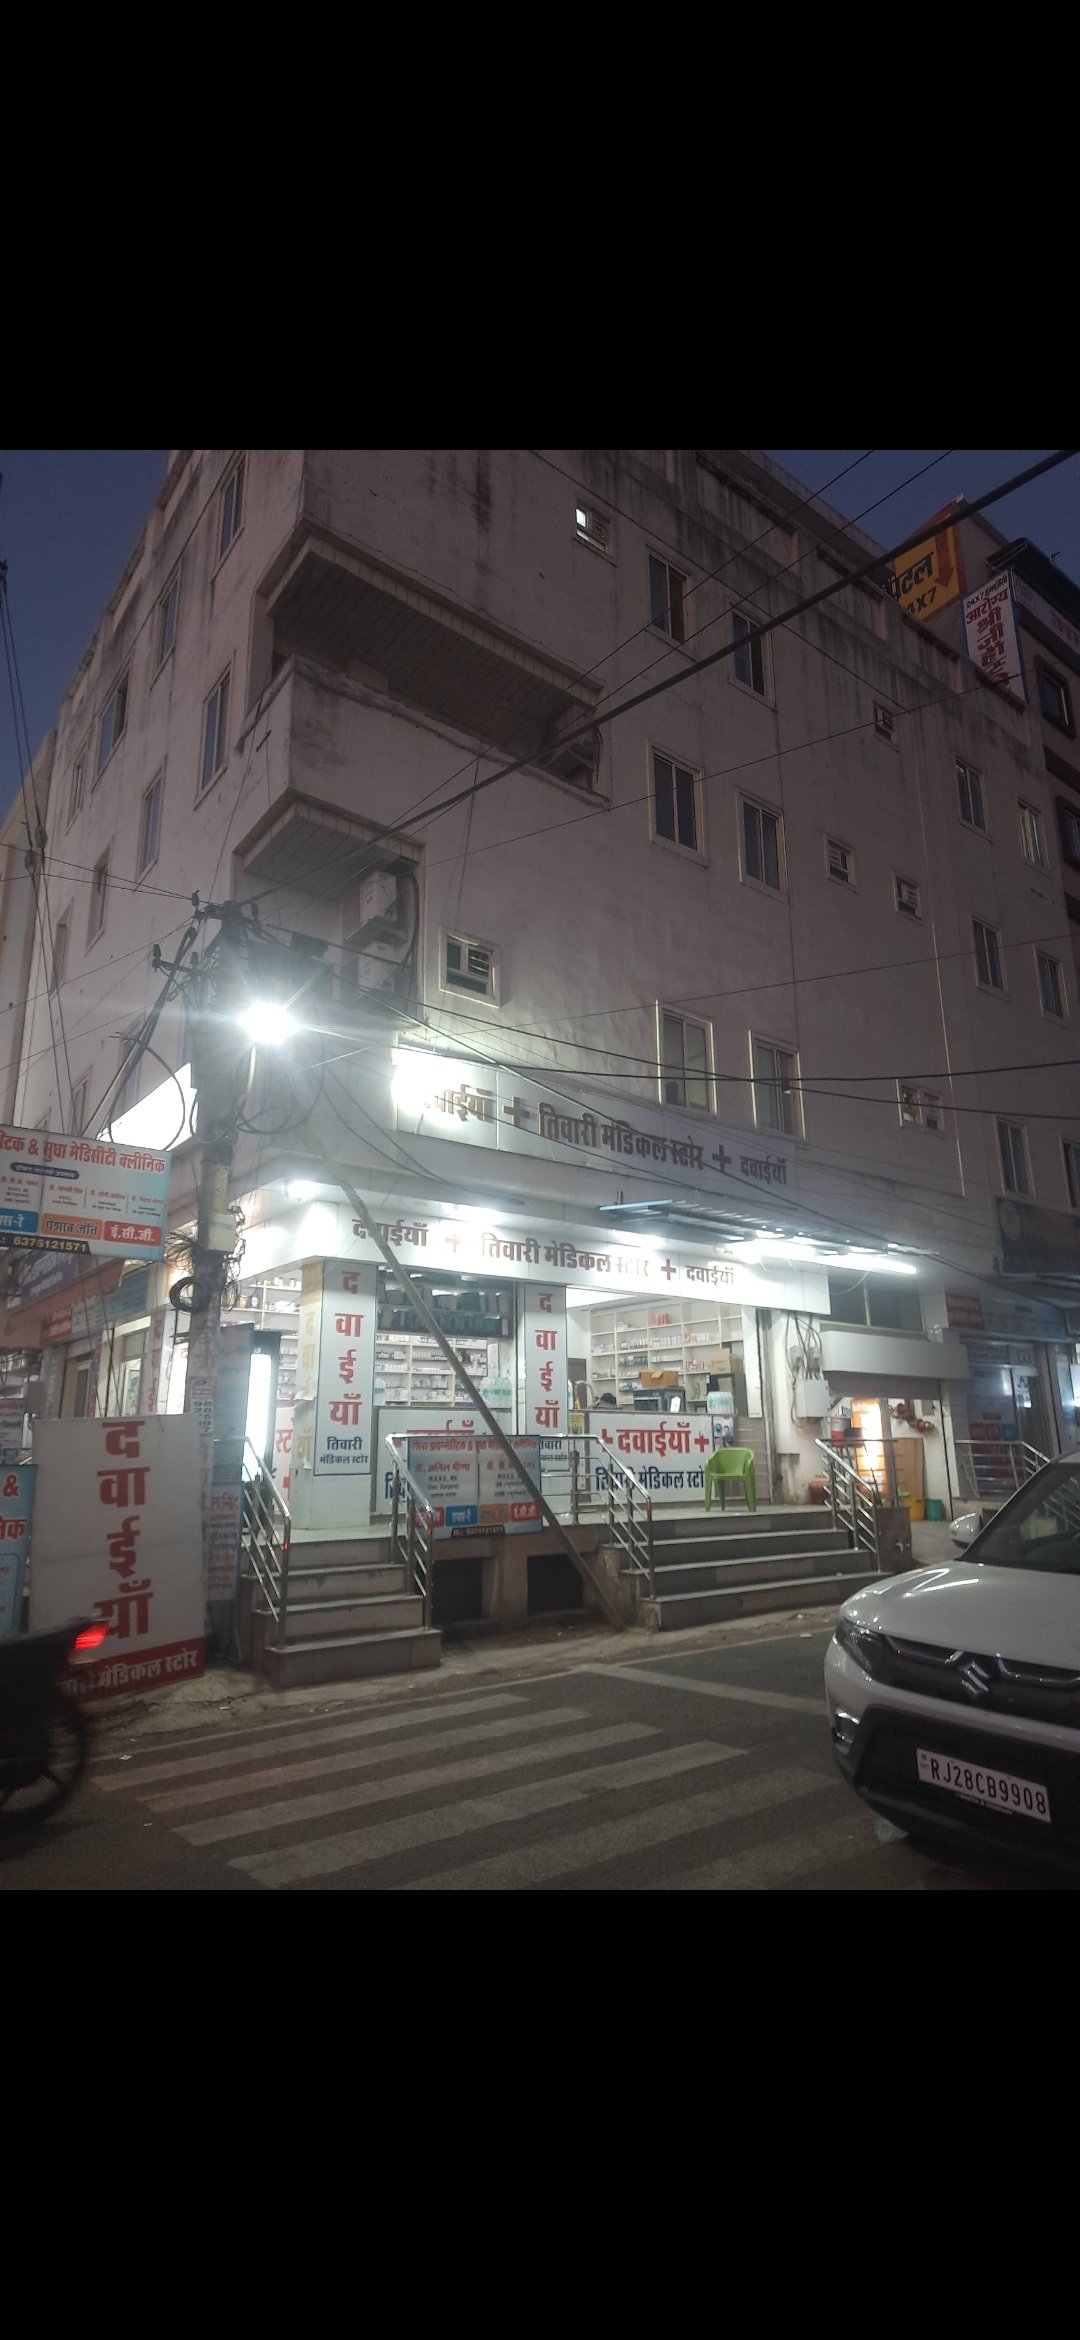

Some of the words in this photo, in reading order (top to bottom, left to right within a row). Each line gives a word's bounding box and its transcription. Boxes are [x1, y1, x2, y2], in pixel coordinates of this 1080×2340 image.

[965, 588, 1009, 625] आरोग्य
[538, 1102, 597, 1148] तिवारी
[601, 1120, 668, 1163] मेडिकल
[670, 1136, 704, 1170] स्टोर
[28, 1139, 38, 1156] &
[119, 1152, 166, 1174] क्लीनिक
[13, 1236, 87, 1252] 6376121571
[352, 1219, 429, 1247] दाईयाँ
[482, 1232, 541, 1264] तिवारी
[543, 1240, 612, 1273] मेडिकल
[319, 1453, 350, 1465] मेडिकल
[352, 1454, 369, 1464] स्टोर
[326, 1436, 363, 1451] तिवारी
[2, 1474, 20, 1498] &
[639, 1465, 684, 1490] मेडिकल
[97, 1662, 162, 1688] मेडिकल
[164, 1648, 198, 1672] स्टोर
[930, 1758, 1047, 1815] RJ28CB9908
